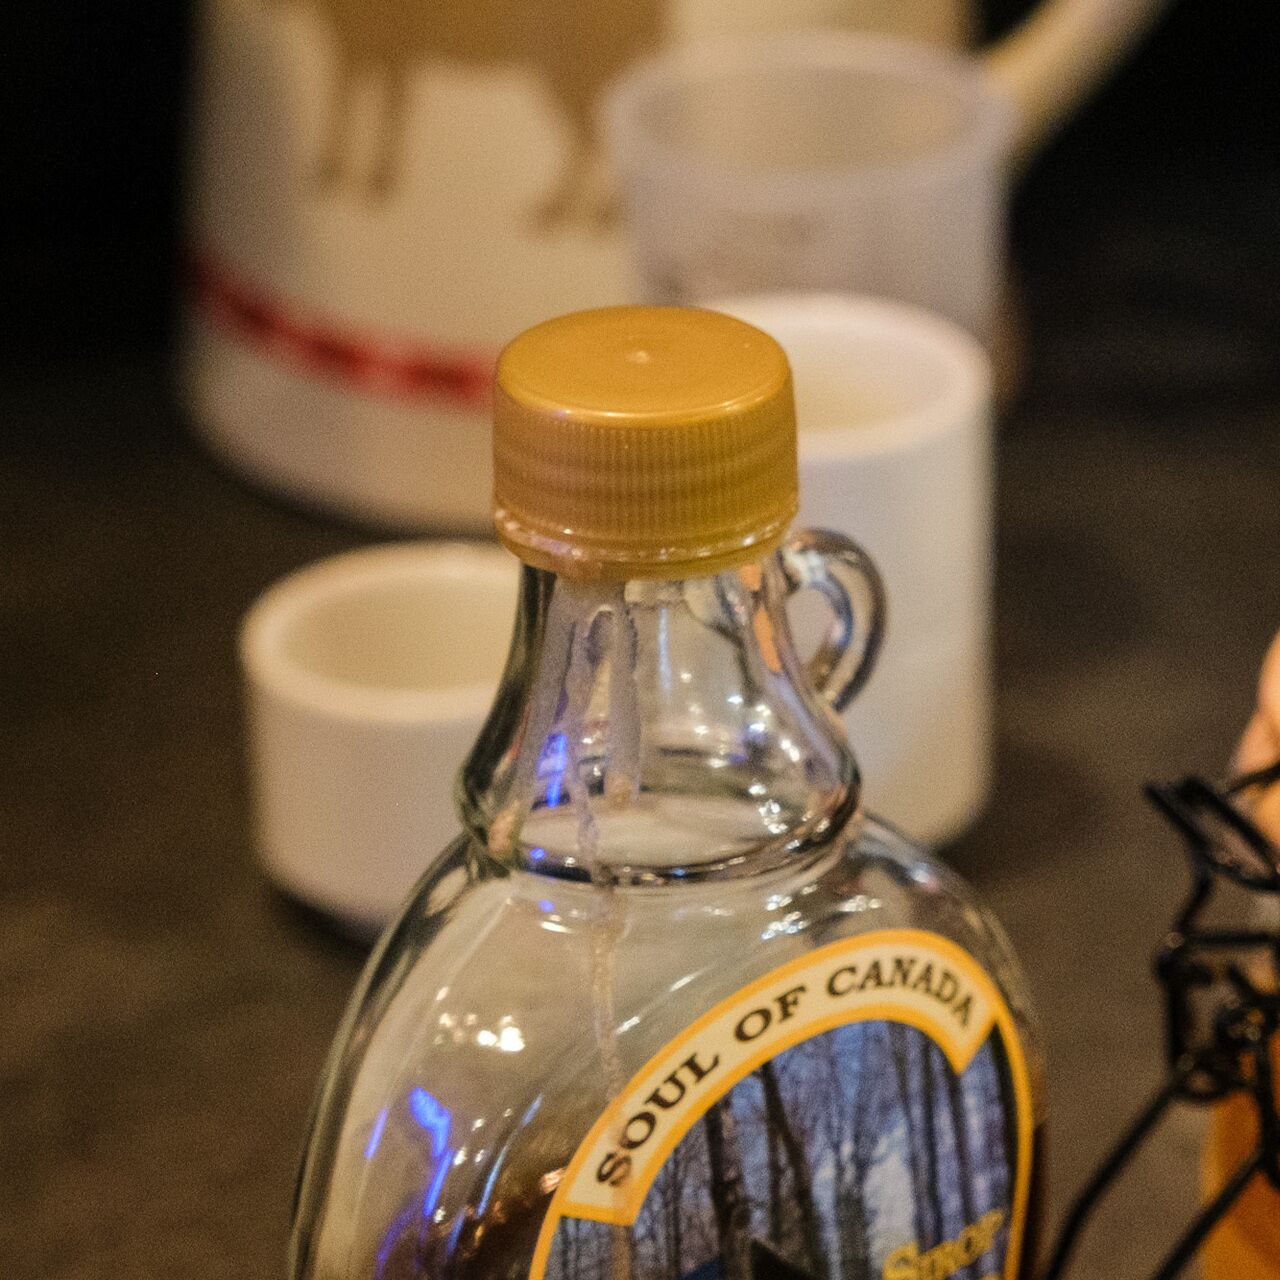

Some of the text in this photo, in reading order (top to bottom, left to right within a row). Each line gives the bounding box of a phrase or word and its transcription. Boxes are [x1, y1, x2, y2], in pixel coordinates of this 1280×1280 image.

[596, 958, 976, 1188] SOUL OF CANADA
